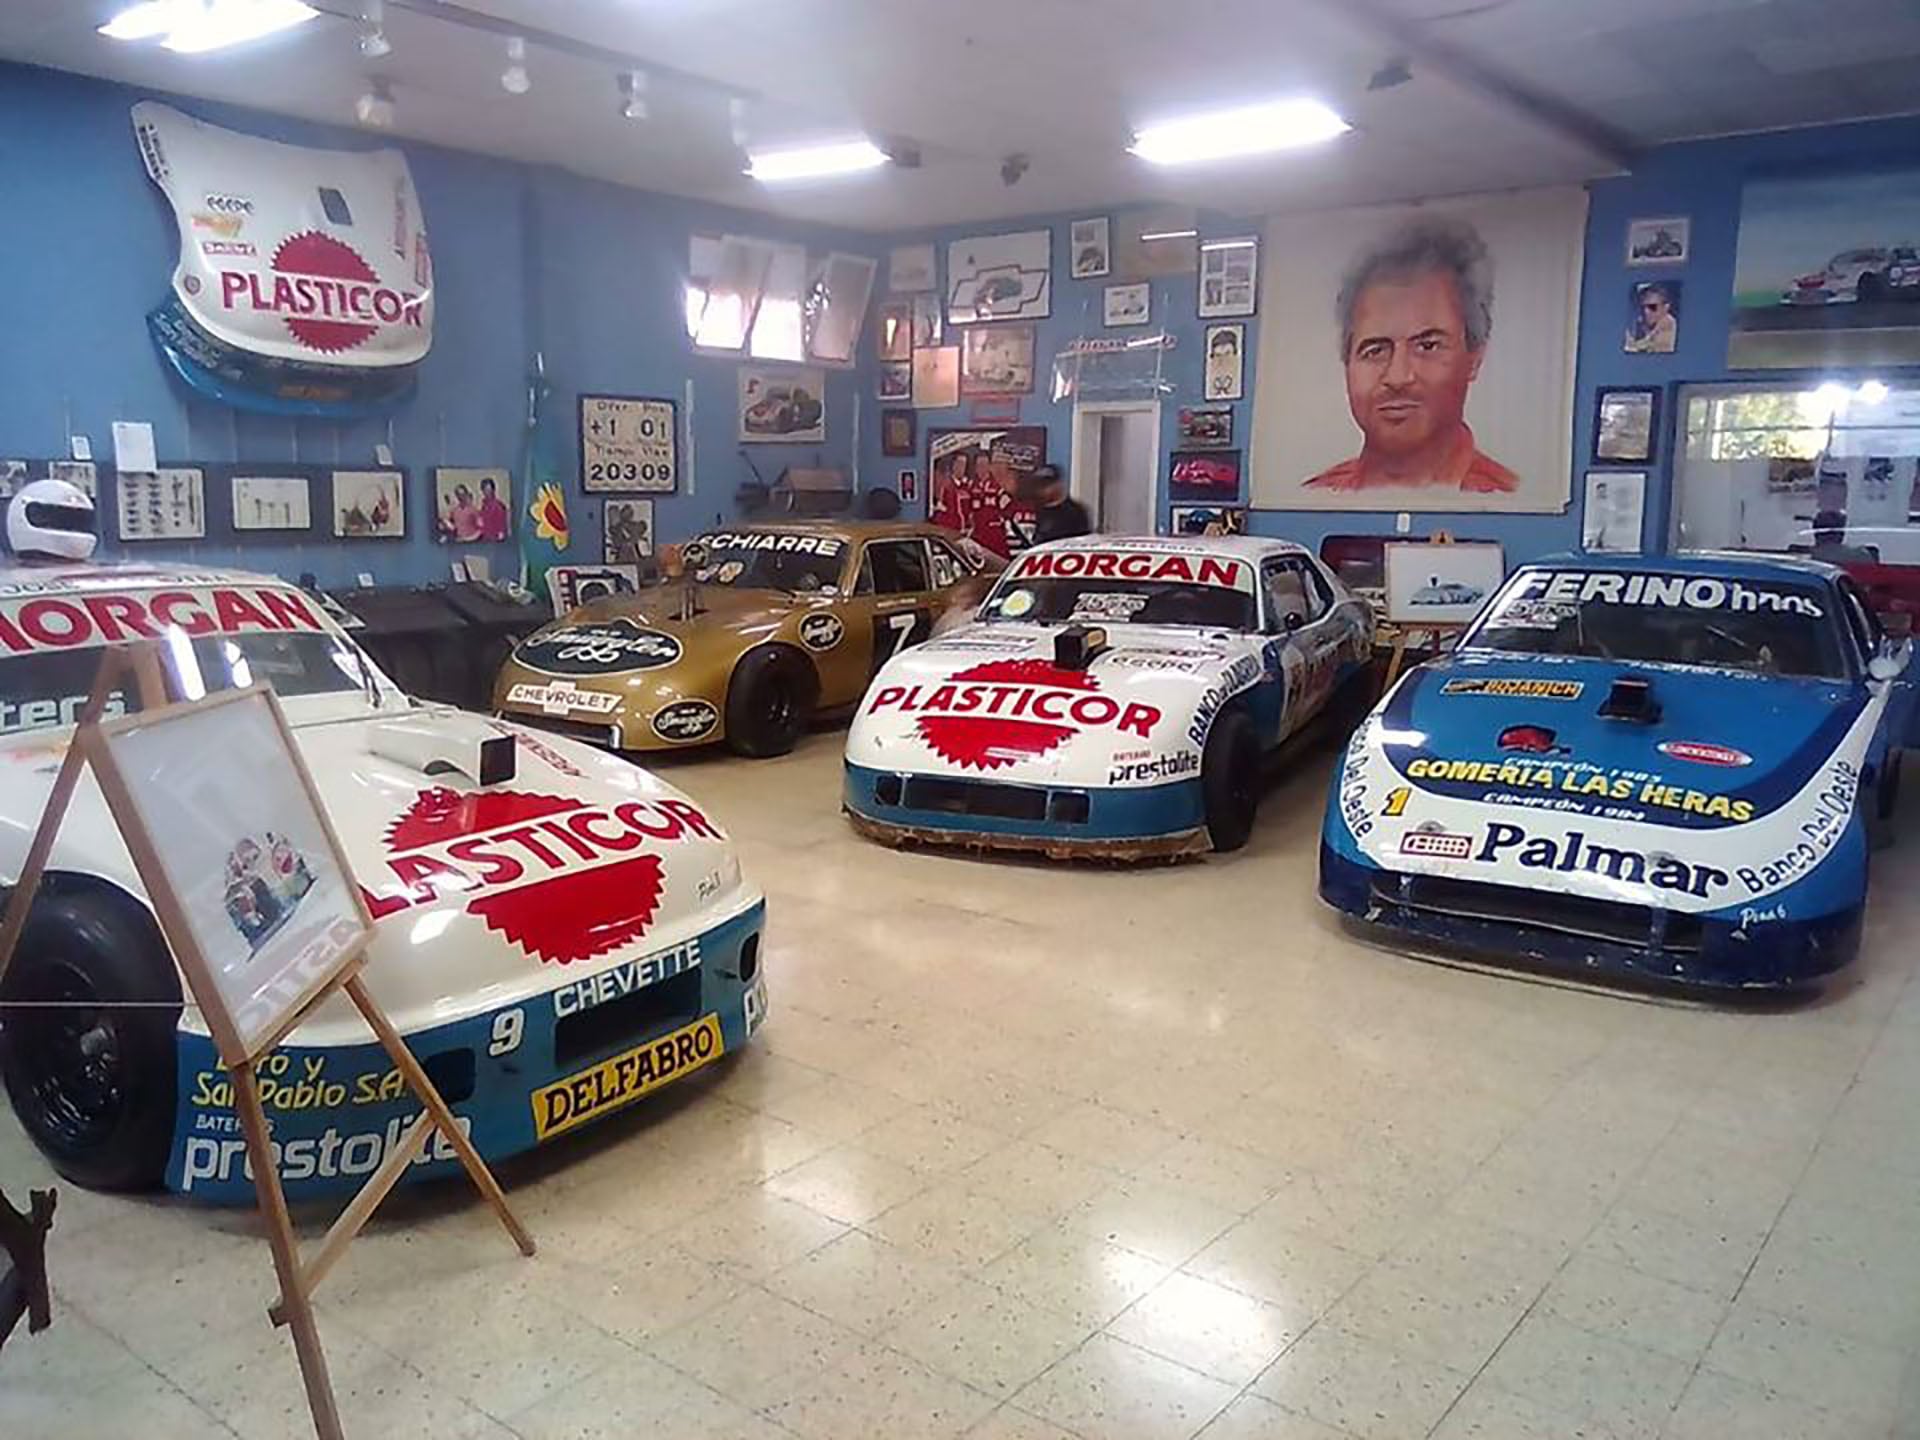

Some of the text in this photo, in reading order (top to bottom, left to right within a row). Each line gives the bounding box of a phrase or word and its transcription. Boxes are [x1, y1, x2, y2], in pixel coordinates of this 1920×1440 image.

[220, 271, 422, 327] PLASTICOR
[1013, 553, 1240, 587] MORGAN
[1513, 573, 1724, 609] FERINO
[889, 614, 916, 658] 7
[514, 683, 611, 708] CHEVROLET
[867, 684, 1162, 739] PLASTICOR
[1188, 688, 1220, 747] BANCO
[1108, 750, 1199, 785] prestolite
[1381, 786, 1411, 817] 1
[1561, 771, 1635, 799] LAS
[1639, 784, 1756, 822] HERAS
[1735, 842, 1817, 894] Banco
[1820, 760, 1858, 815] Oeste
[1475, 821, 1729, 899] Palmar
[553, 939, 701, 1018] CHEVETTE
[489, 1007, 524, 1057] 9
[256, 1077, 347, 1109] Pablo
[543, 1024, 713, 1132] DELFABRO
[195, 1113, 275, 1135] BATES
